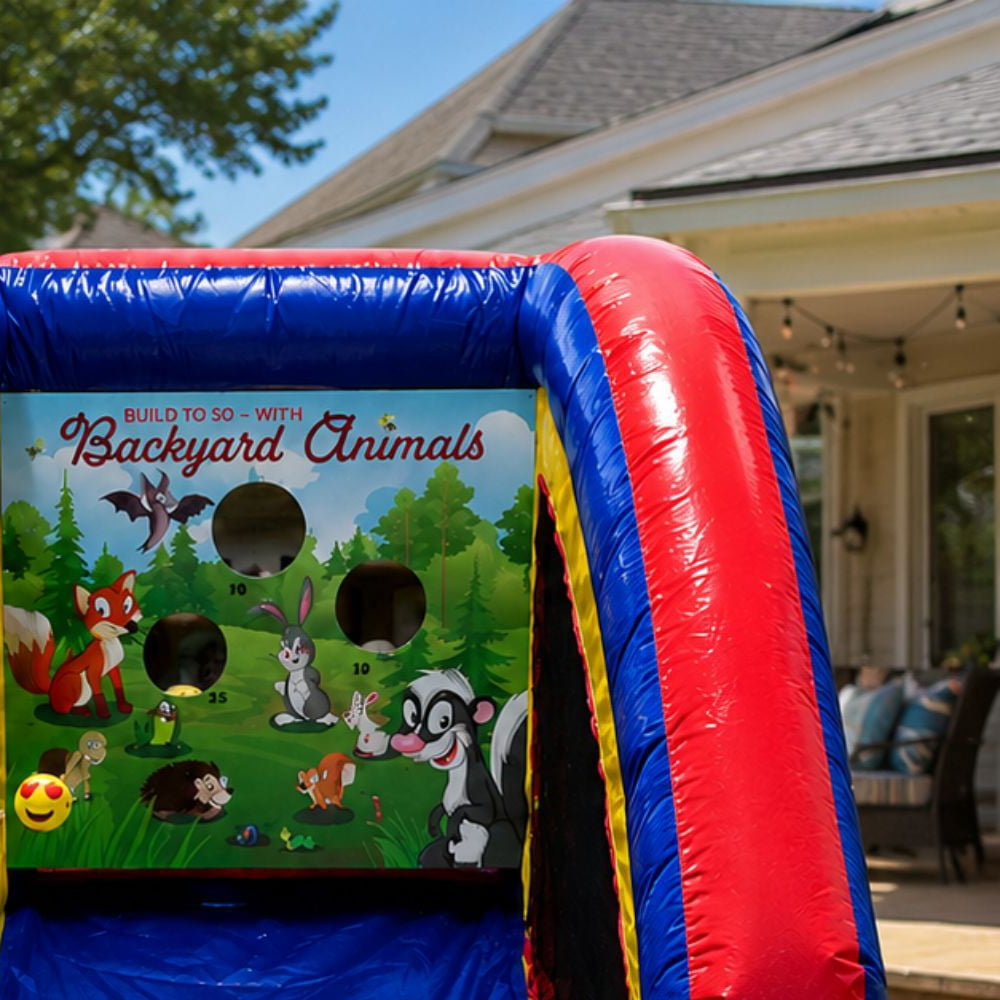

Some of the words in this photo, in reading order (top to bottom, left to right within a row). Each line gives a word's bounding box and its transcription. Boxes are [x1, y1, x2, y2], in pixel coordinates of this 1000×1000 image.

[124, 408, 177, 422] BUILD
[182, 407, 206, 422] TO
[211, 407, 234, 422] SO
[255, 407, 302, 421] WITH
[60, 412, 285, 478] Backyard
[304, 410, 484, 464] Animals
[229, 584, 247, 596] 10
[353, 663, 371, 675] 10
